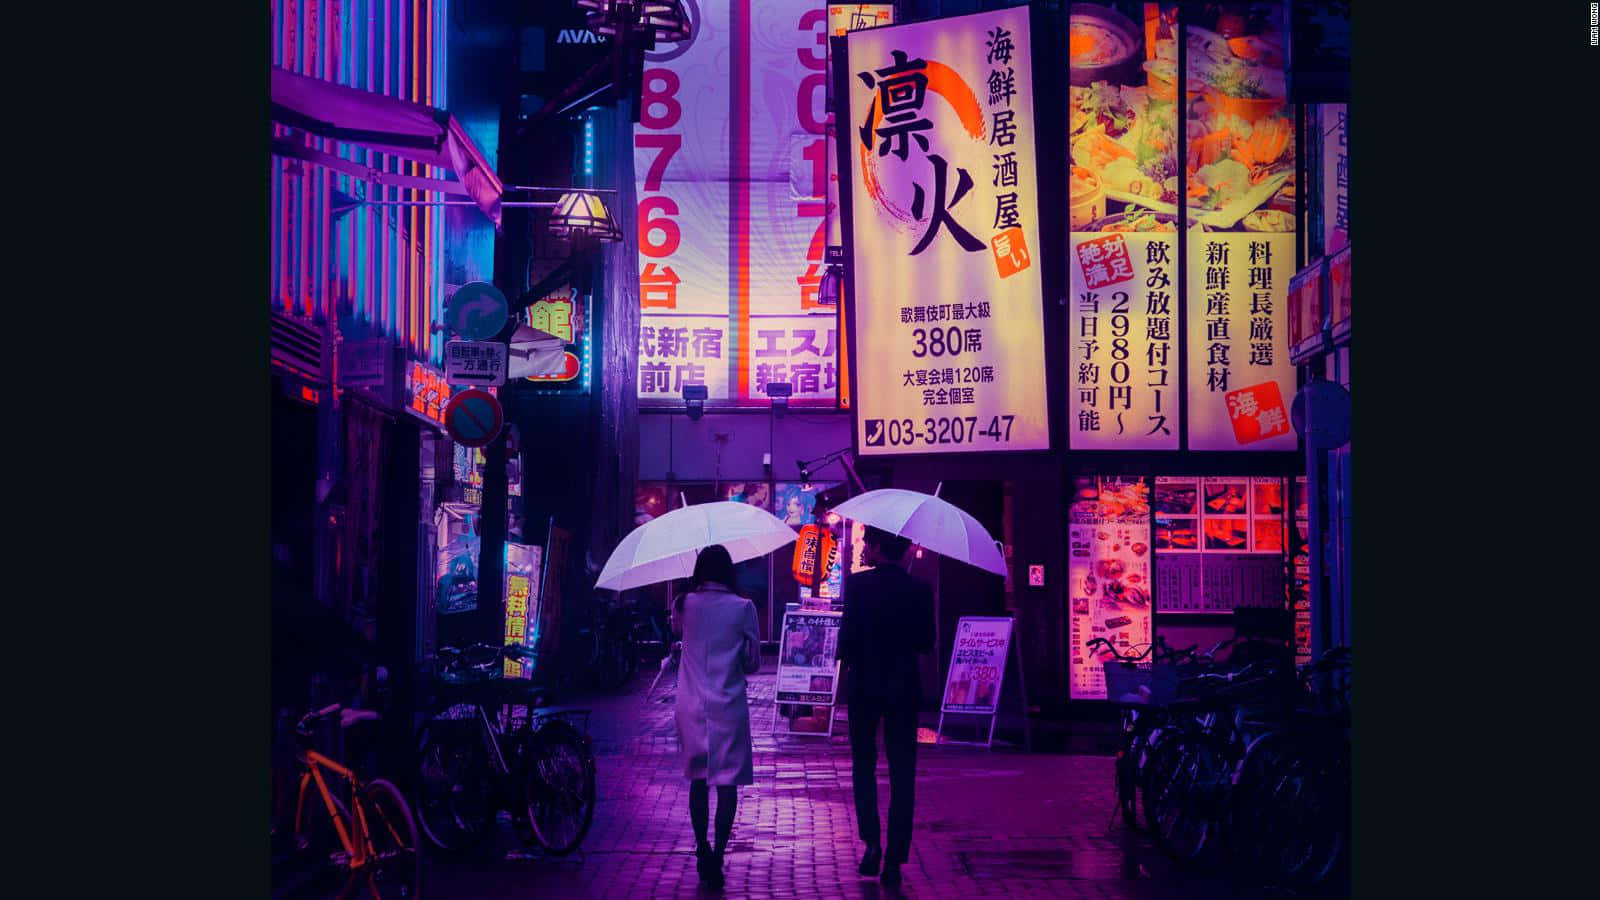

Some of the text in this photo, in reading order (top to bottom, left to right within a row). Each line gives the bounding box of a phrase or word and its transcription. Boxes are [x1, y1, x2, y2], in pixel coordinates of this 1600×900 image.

[985, 26, 1022, 230] 海鮮居酒屋
[994, 234, 1029, 269] 旨い
[900, 302, 991, 323] 歌舞伎町最大級
[1205, 241, 1231, 392] 新鮮産直食材
[1248, 240, 1273, 366] 料理長厳選
[912, 326, 982, 358] 380席
[1145, 240, 1171, 436] 飲み放題付コース
[450, 359, 500, 371] 一方通行
[903, 366, 994, 387] 大宴会場120席
[1078, 292, 1100, 432] 当日予約可能
[922, 387, 975, 406] 完全個室
[1229, 390, 1286, 435] 海鮮
[888, 415, 1015, 446] 03-3207-47
